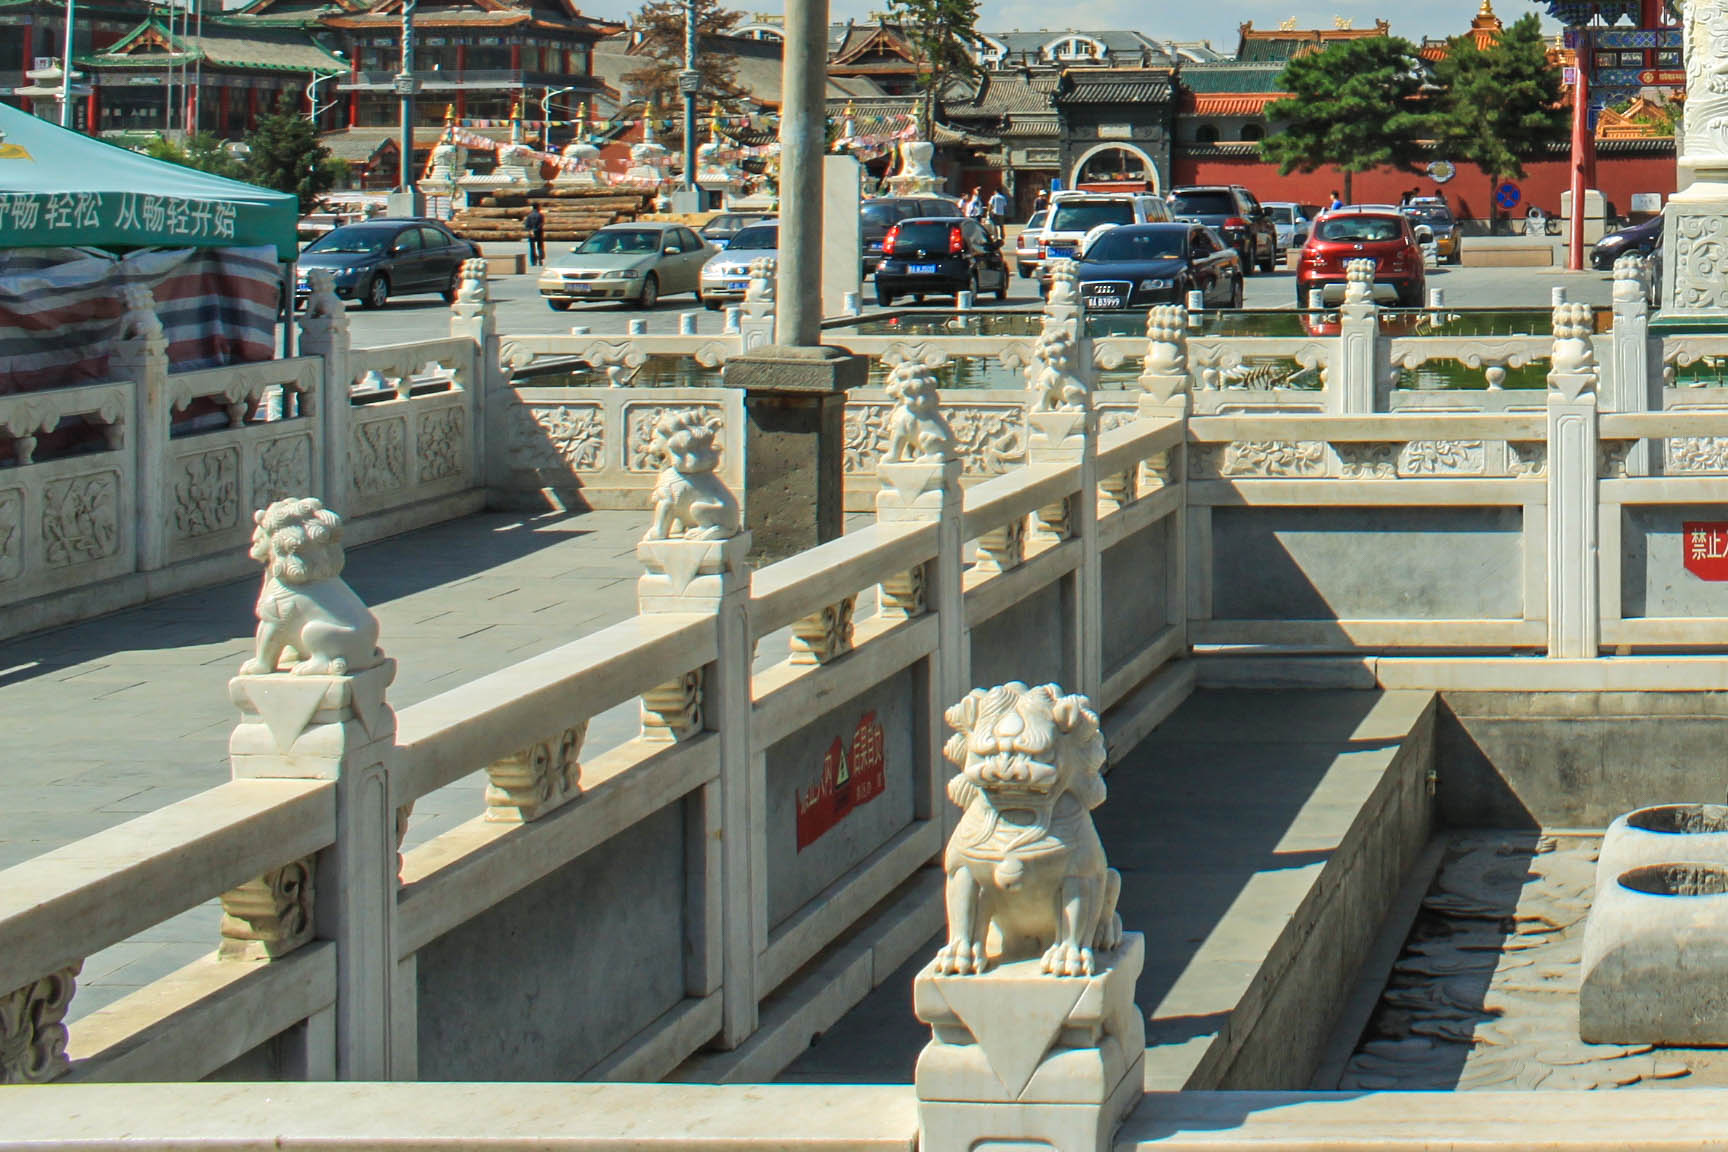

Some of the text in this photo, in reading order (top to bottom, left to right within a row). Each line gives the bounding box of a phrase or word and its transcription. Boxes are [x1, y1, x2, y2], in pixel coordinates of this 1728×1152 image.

[44, 193, 102, 230] 轻松
[115, 193, 238, 239] 从畅轻开始
